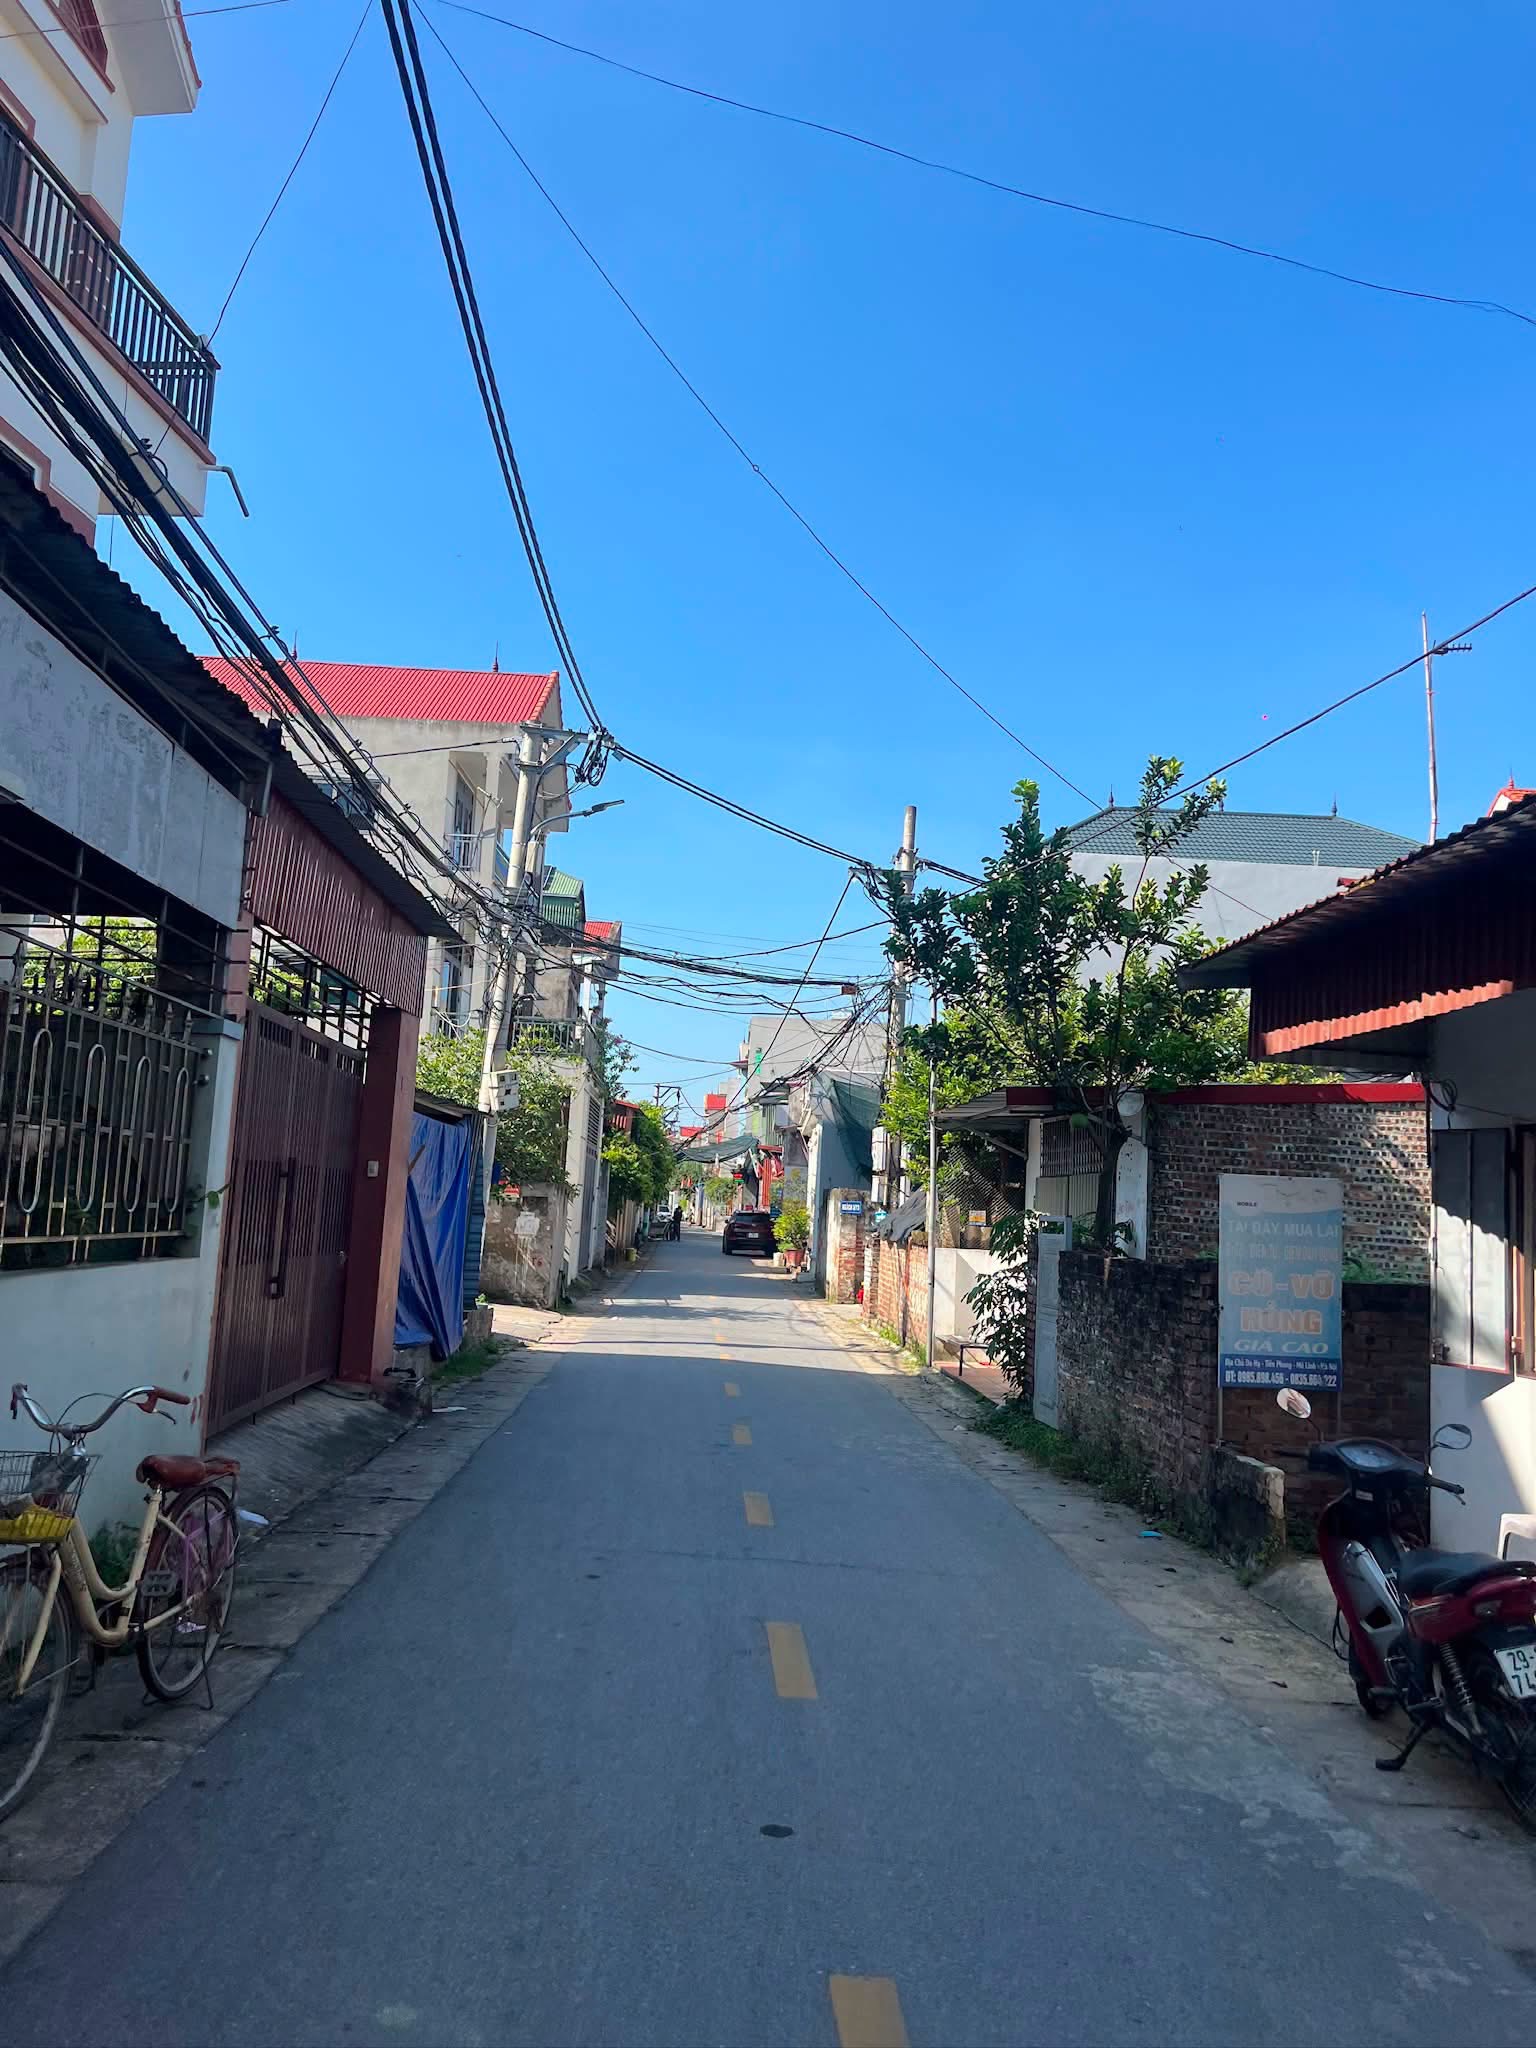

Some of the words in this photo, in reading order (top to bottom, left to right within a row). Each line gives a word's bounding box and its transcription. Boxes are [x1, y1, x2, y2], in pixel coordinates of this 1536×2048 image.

[1284, 1223, 1312, 1236] MUA
[1234, 1337, 1273, 1352] GIÁ
[1281, 1341, 1329, 1354] CAO
[1506, 1646, 1536, 1671] 29-
